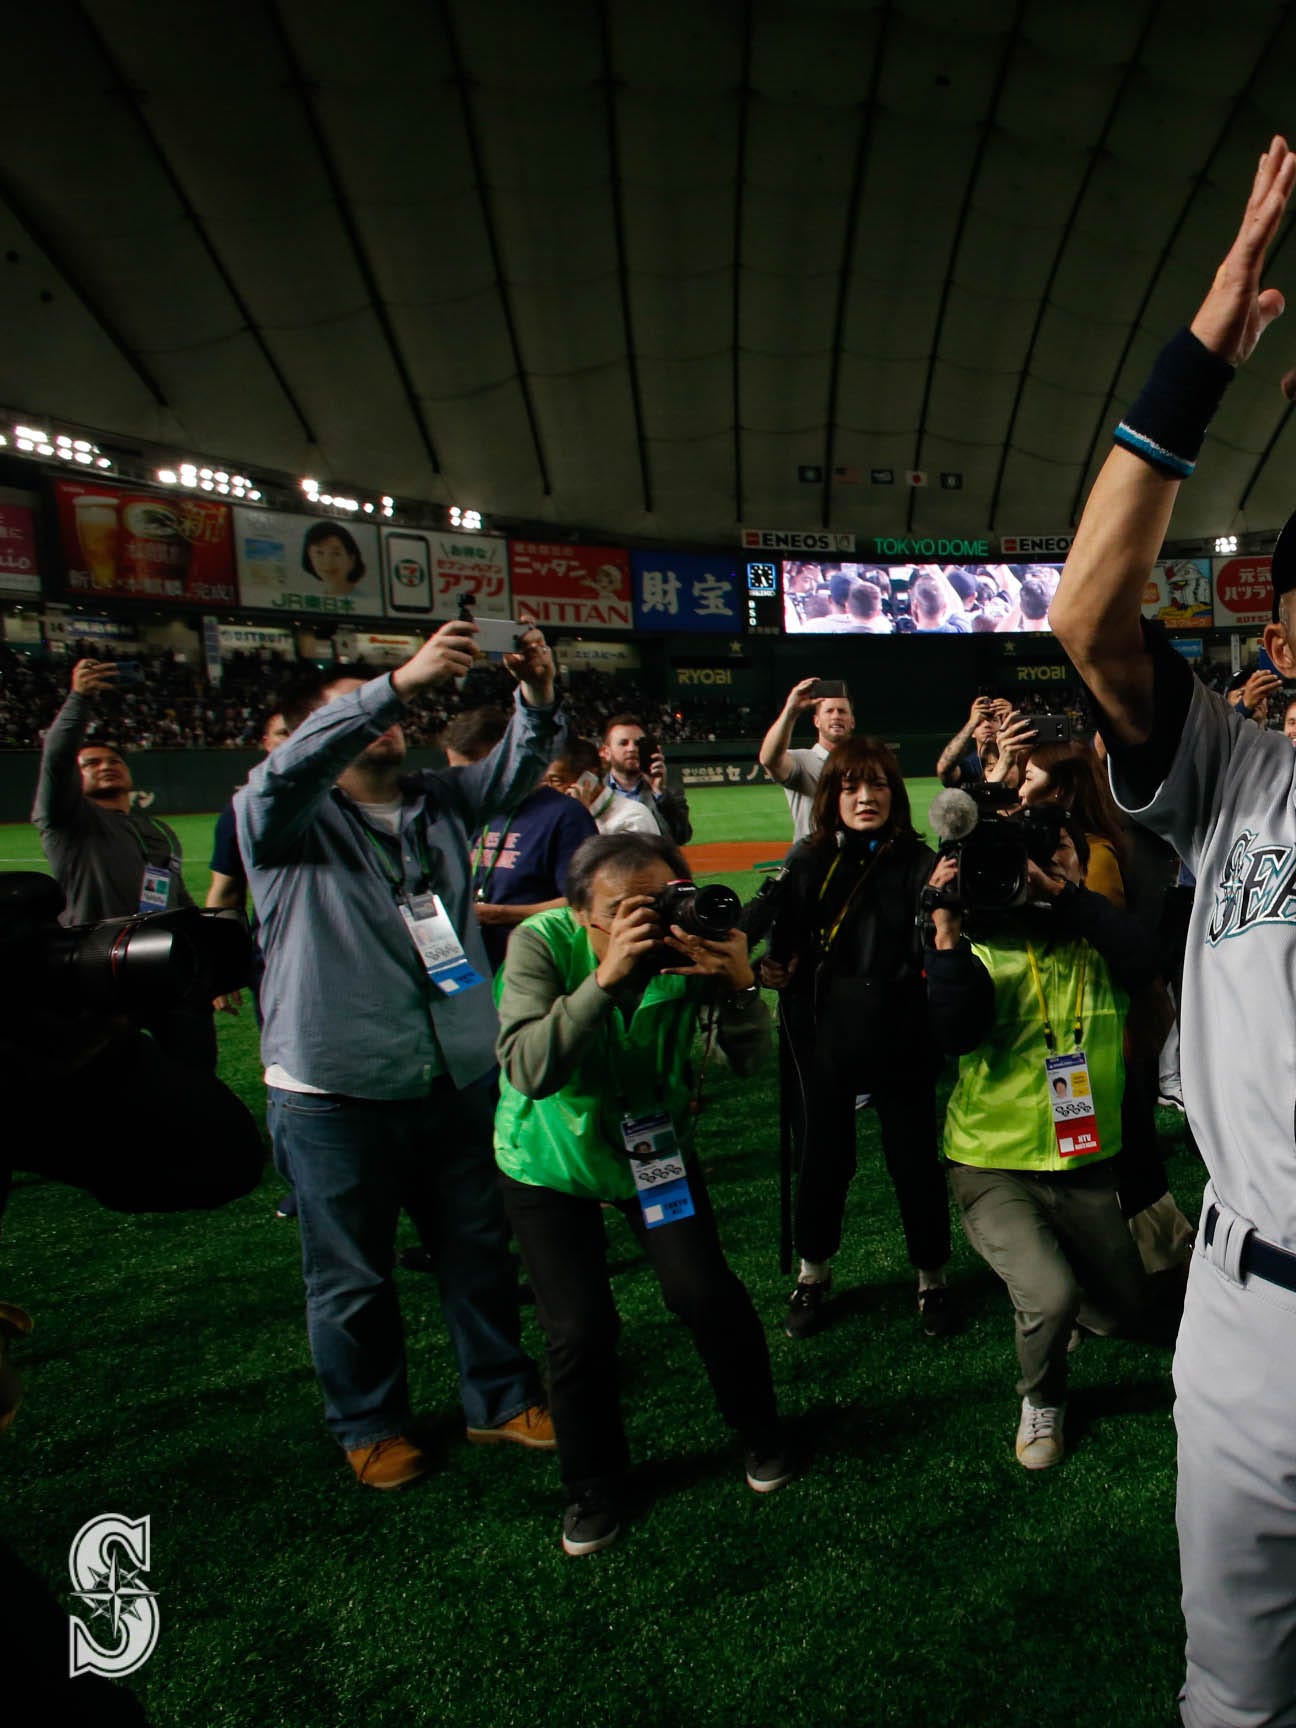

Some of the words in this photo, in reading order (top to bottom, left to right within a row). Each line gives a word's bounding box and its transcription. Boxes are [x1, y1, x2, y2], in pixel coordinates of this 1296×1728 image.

[762, 532, 830, 551] ENEOS
[874, 538, 936, 560] TOKYO
[936, 540, 990, 561] DOME
[1019, 539, 1074, 557] ENEO
[513, 555, 588, 578] ニッタン
[437, 573, 505, 598] アプリ
[640, 571, 734, 617] 財宝
[272, 593, 354, 612] JR東日本
[517, 602, 630, 624] NITTAN
[676, 668, 733, 686] RYOBI
[1016, 665, 1067, 685] RYOBI
